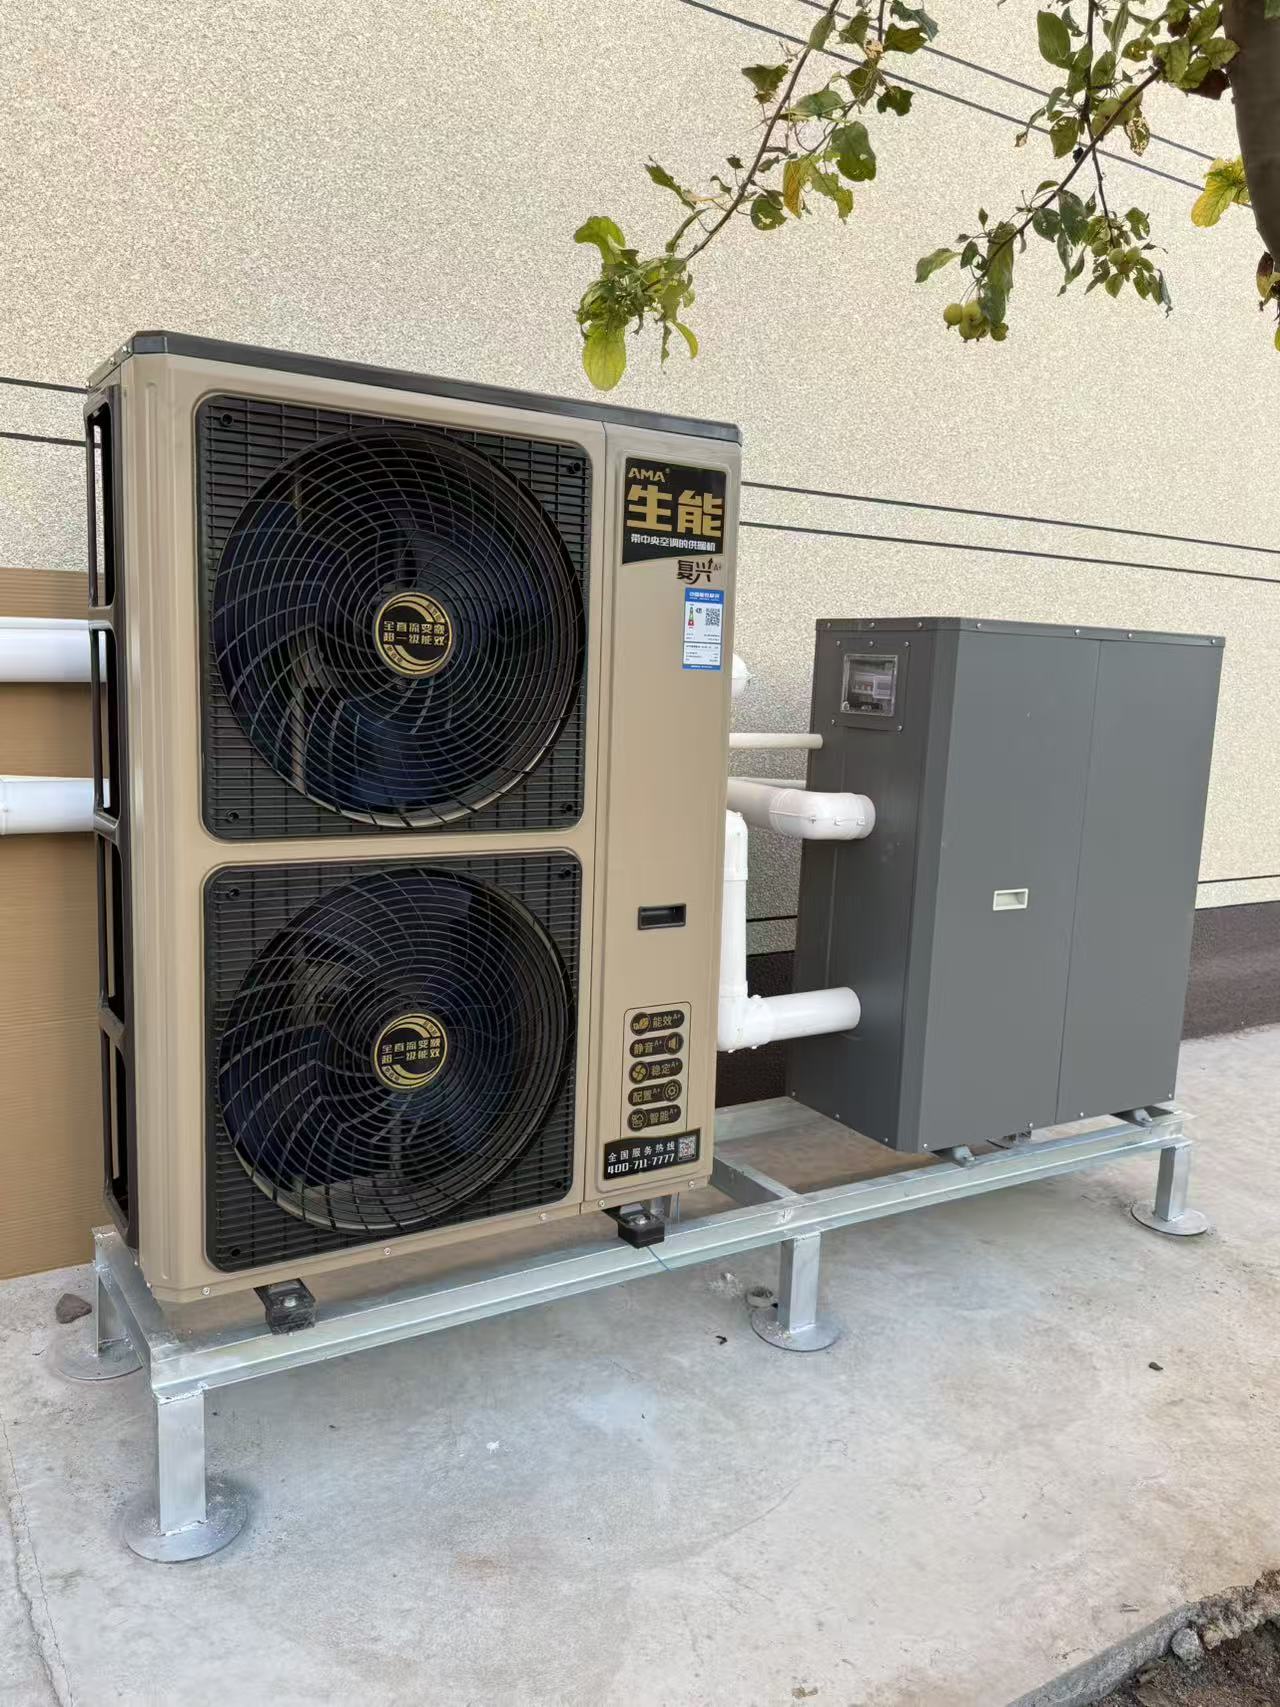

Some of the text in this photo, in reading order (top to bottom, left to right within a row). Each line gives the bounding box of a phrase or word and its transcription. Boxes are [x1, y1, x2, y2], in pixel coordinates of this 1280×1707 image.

[628, 467, 665, 483] AMA
[627, 484, 723, 538] 生能
[676, 557, 714, 585] 复兴
[608, 1141, 675, 1163] 全国服务热线
[607, 1153, 675, 1174] 400-711-7777
